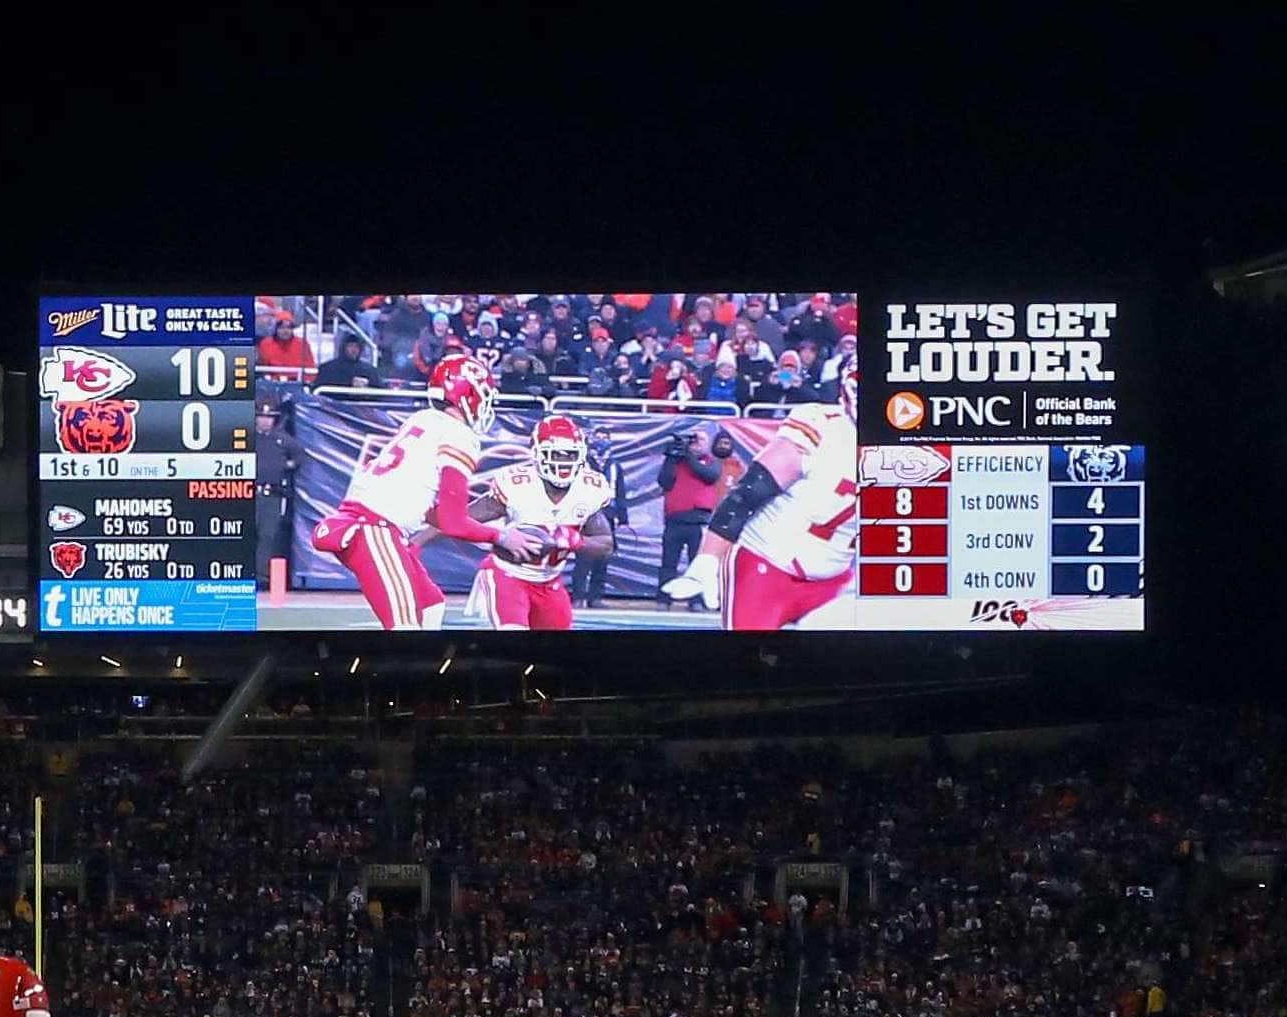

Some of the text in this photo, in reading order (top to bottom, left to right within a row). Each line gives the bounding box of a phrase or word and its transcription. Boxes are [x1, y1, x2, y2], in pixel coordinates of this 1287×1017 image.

[49, 303, 157, 339] Miller Lite
[166, 308, 243, 319] GREAT TASTE.
[886, 303, 1117, 339] LET'S GET
[166, 321, 244, 332] ONLY 96 CALS.
[886, 341, 1115, 382] LOUDER.
[63, 360, 112, 392] KC
[171, 347, 226, 396] 10
[929, 396, 1011, 427] PNC
[1035, 398, 1116, 410] Official Bank
[181, 402, 211, 450] 0
[1035, 413, 1112, 426] of the Bears
[51, 457, 244, 477] 1st & 10 ON THE 5 2nd
[957, 456, 1043, 473] EFFICIENCY
[189, 481, 253, 499] PASSING
[95, 499, 172, 517] MAHOMES
[895, 486, 1105, 515] 8 1st DOWNS 4
[103, 517, 243, 534] 69 YDS 0 TD 0 INT
[895, 525, 1104, 553] 3 3rd CONV 2
[95, 543, 169, 560] TRUBISKY
[103, 562, 243, 579] 26 YDS 0 TD 0 INT
[895, 565, 1104, 592] 0 4th CONV 0
[71, 587, 139, 606] LIVE ONLY
[196, 584, 256, 594] ticketmaster
[44, 584, 66, 627] t
[71, 606, 174, 625] HAPPENS ONCE
